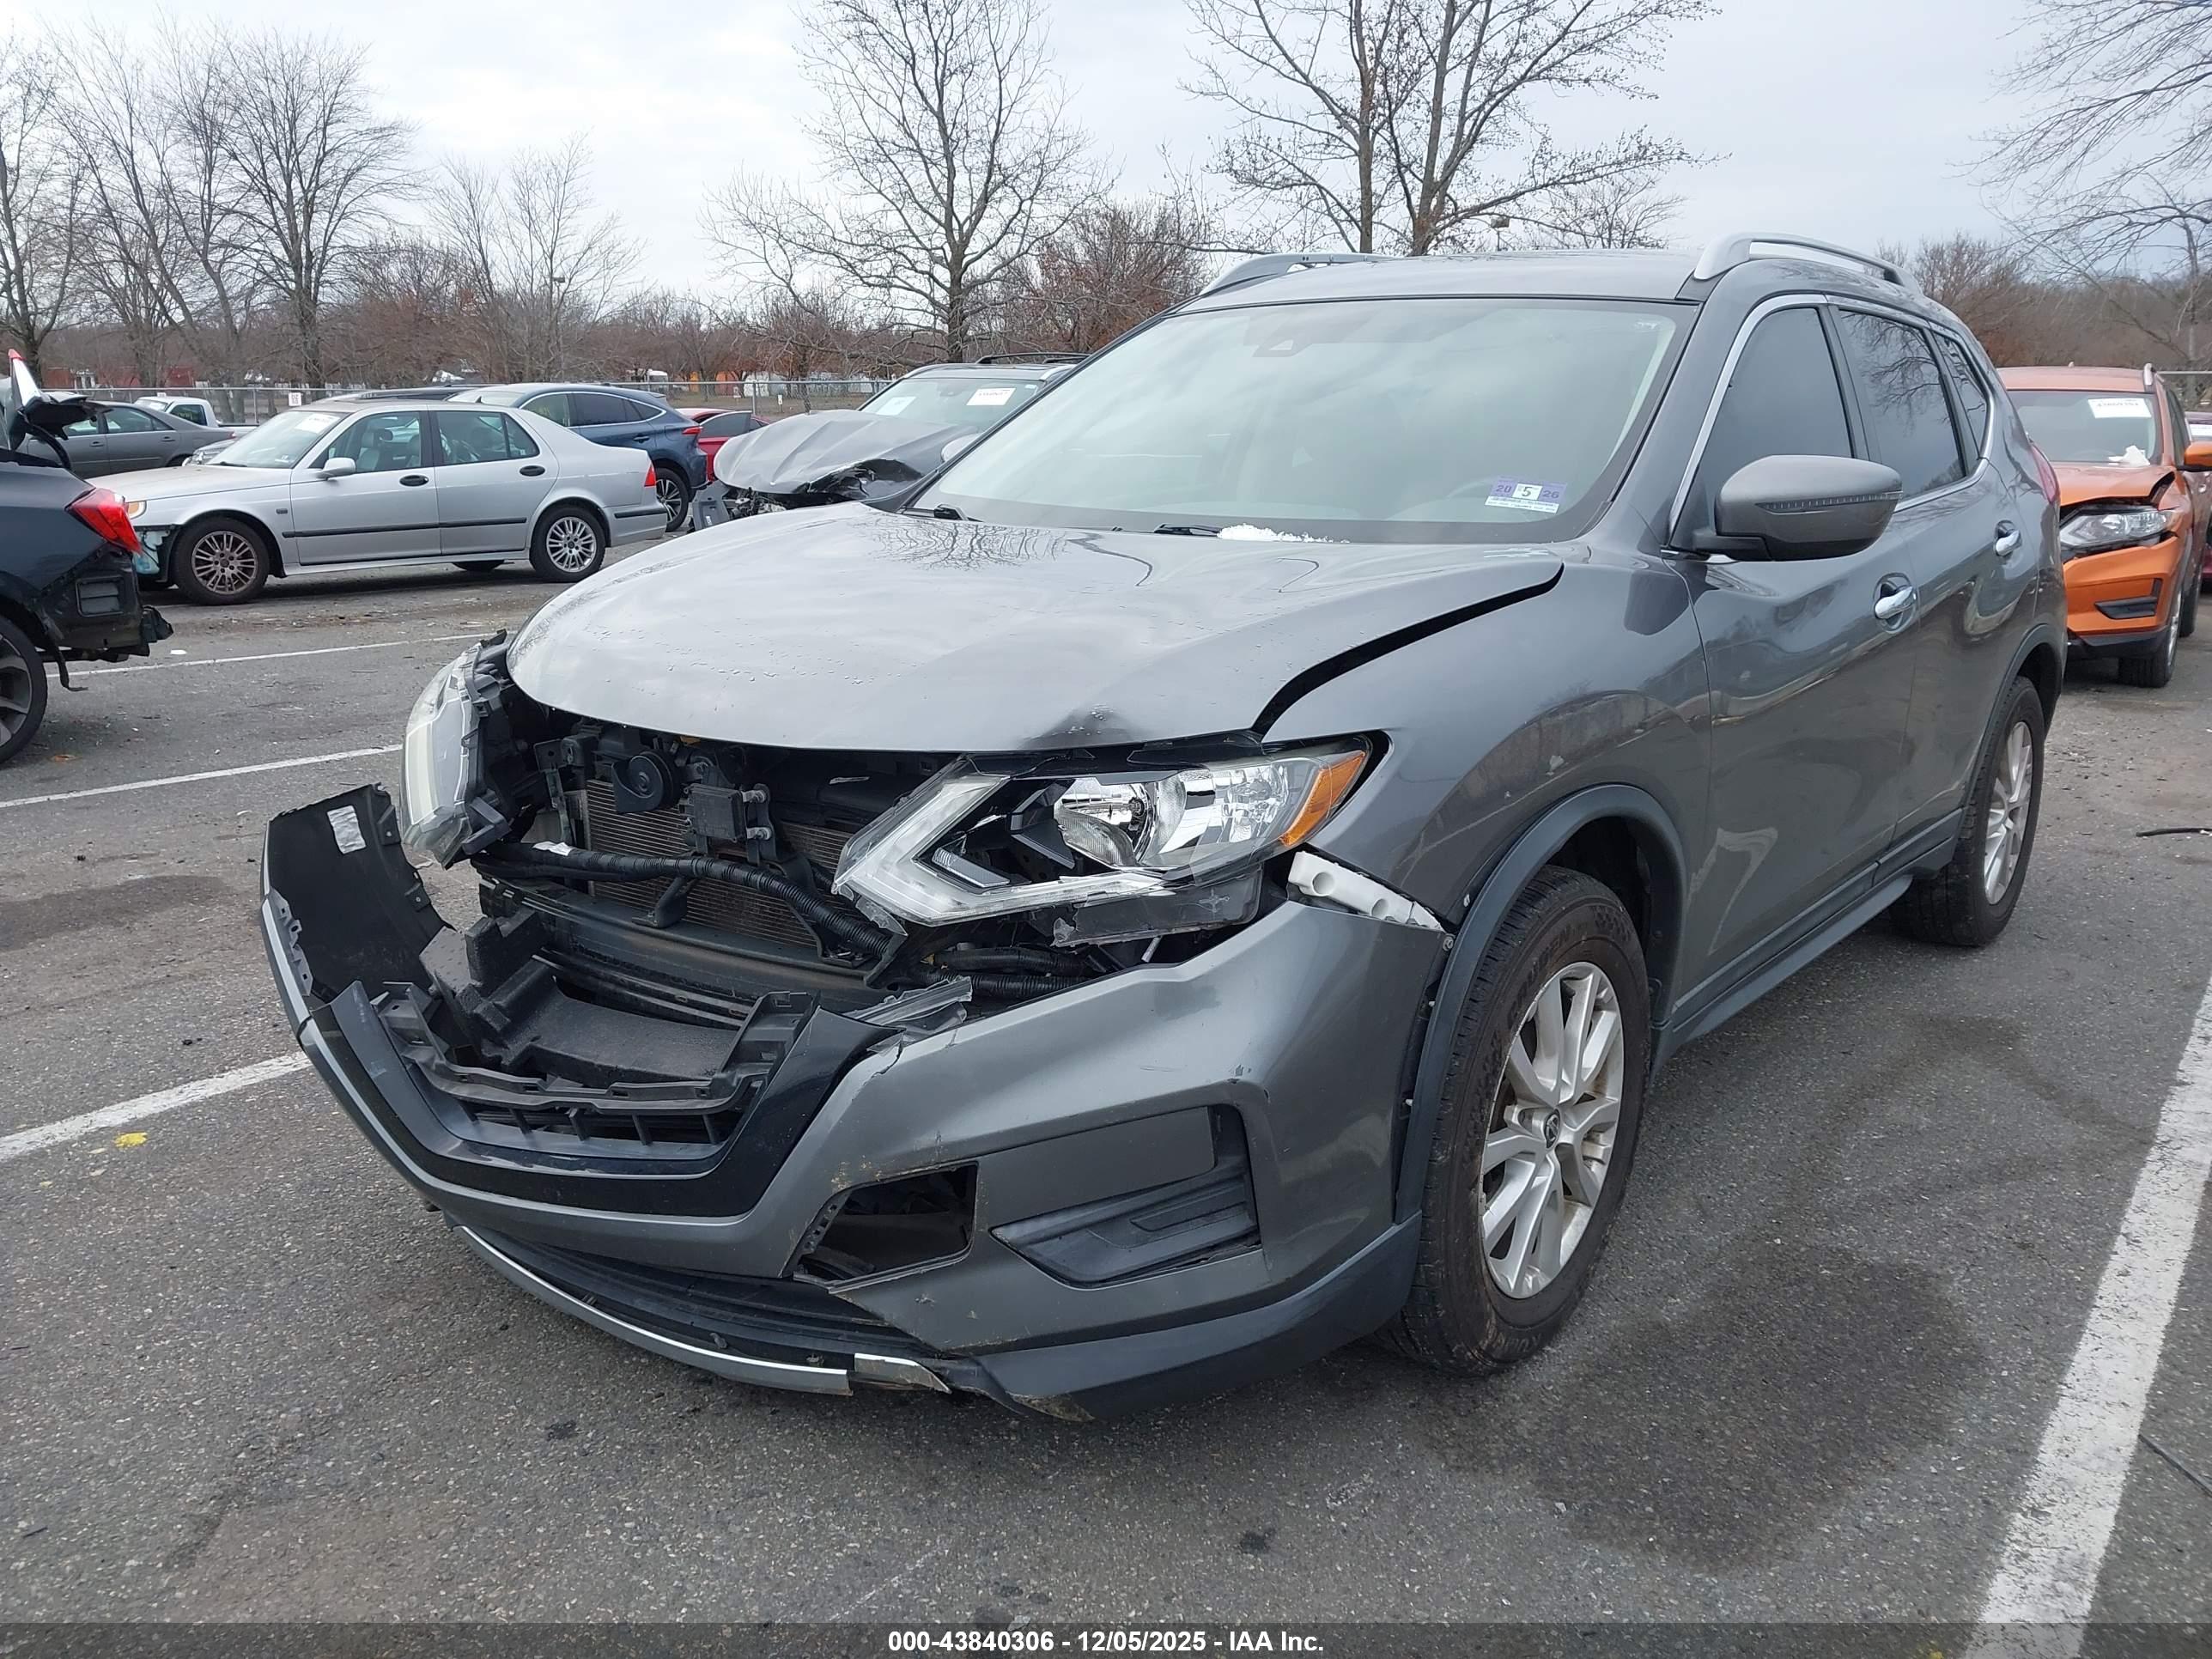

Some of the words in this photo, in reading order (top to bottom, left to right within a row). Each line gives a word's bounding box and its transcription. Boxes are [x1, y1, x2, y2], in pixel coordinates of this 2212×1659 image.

[1496, 484, 1512, 494] 20
[1522, 486, 1533, 497] 5
[1542, 490, 1559, 499] 26
